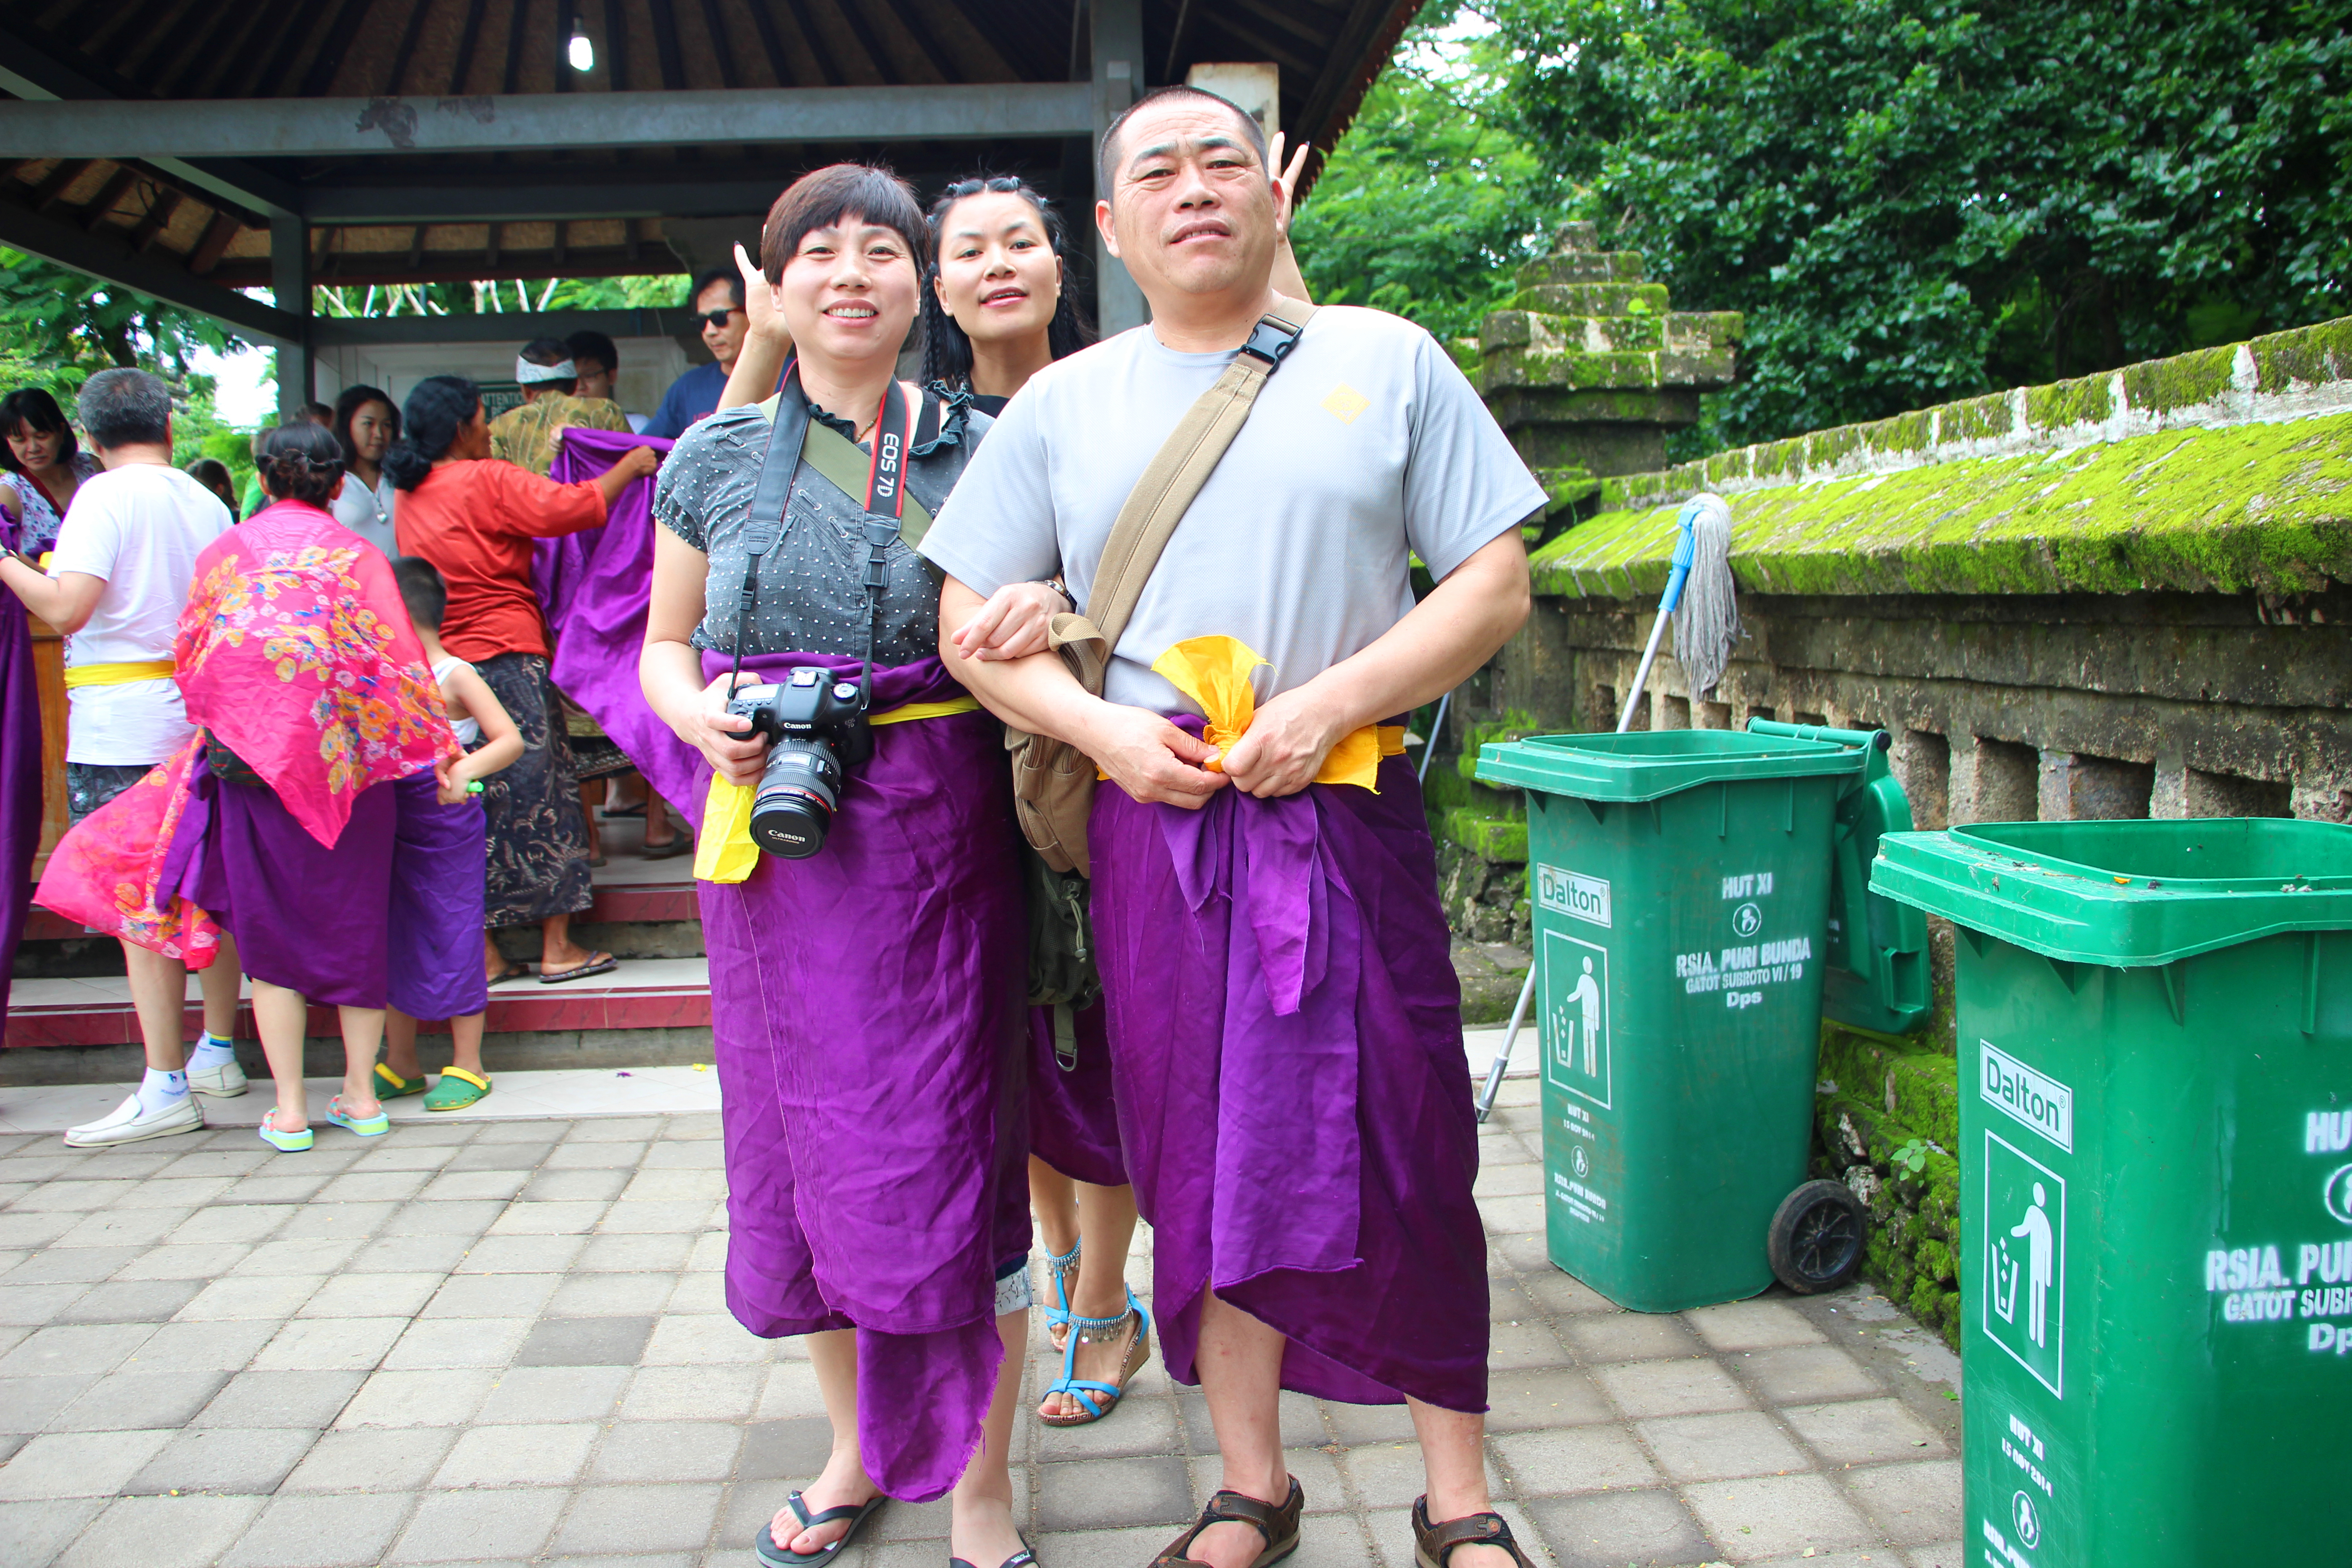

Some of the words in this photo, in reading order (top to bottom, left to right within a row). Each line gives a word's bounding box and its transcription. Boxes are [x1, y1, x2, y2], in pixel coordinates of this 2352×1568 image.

[481, 392, 523, 407] ATTENTIO
[881, 432, 900, 473] EOS
[877, 476, 895, 497] 7D
[783, 722, 812, 730] Canon
[768, 829, 806, 843] Canon
[772, 836, 800, 844] ULTRASONIC
[1543, 873, 1601, 915] Dalton
[1722, 874, 1754, 899] HUT
[1757, 872, 1772, 895] XI
[1720, 945, 1758, 972] PURI
[1761, 937, 1811, 966] BUNDA
[1686, 974, 1720, 994] GATOT
[1722, 968, 1770, 989] SUBROTO
[1726, 991, 1763, 1009] Dps
[1986, 1054, 2059, 1132] Dalton
[2306, 1111, 2352, 1152] HU
[2298, 1240, 2352, 1285] PU
[2224, 1290, 2297, 1321] GATOT
[2308, 1323, 2352, 1354] Dp
[2002, 1437, 2012, 1458] 15
[2010, 1413, 2032, 1448] HUT
[2032, 1434, 2044, 1461] XI
